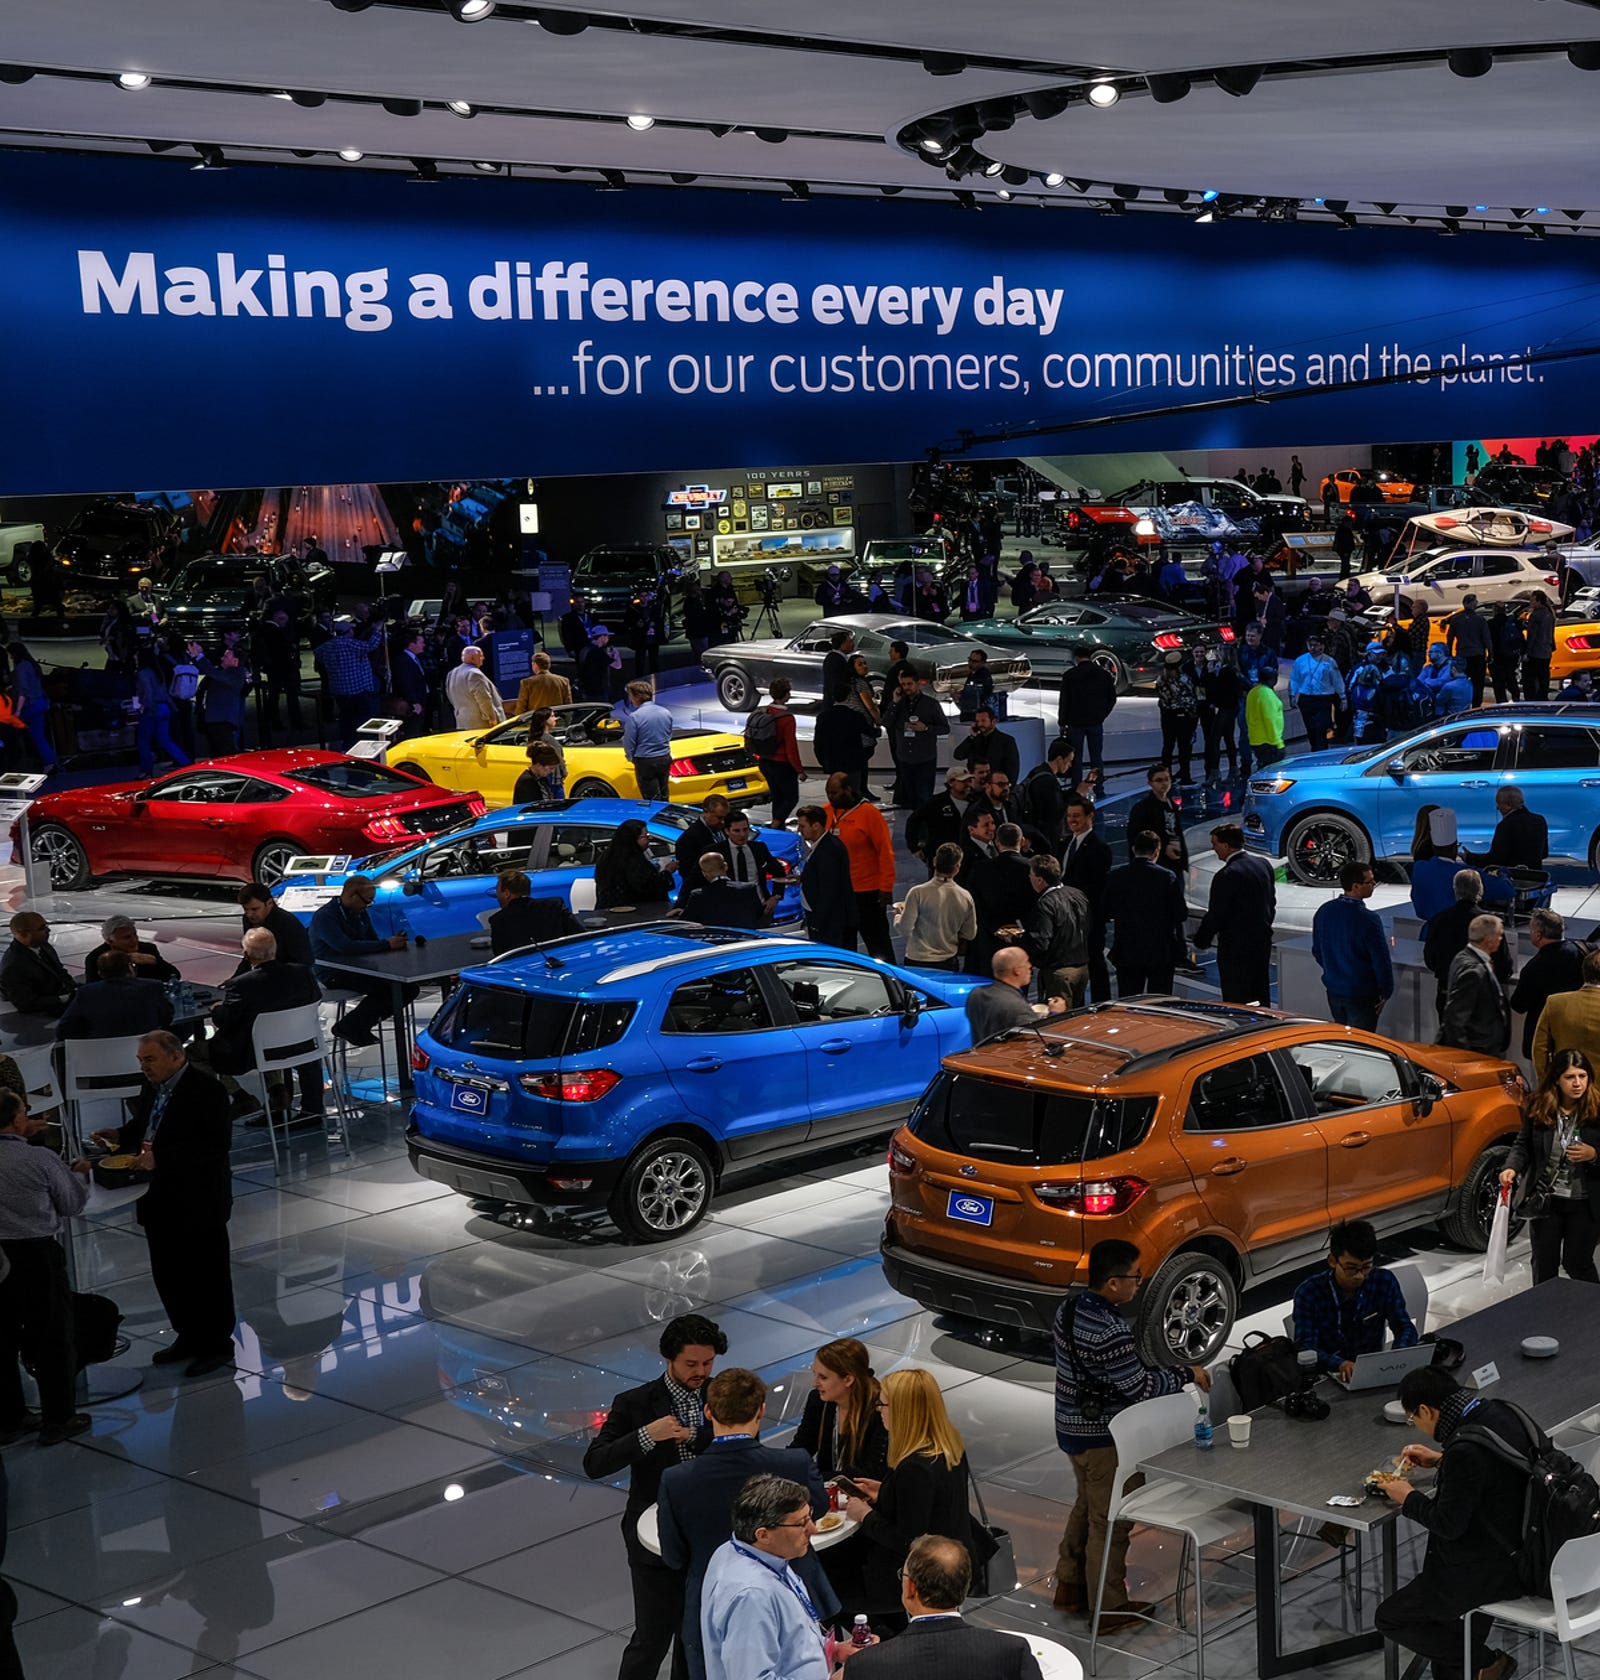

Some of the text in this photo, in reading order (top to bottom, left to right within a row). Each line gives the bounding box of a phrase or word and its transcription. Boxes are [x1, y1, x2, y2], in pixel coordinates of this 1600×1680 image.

[77, 249, 1065, 336] Making a difference every day
[667, 353, 755, 395] our
[769, 344, 1030, 396] customers,
[1041, 342, 1296, 389] communities
[1305, 342, 1370, 387] and
[1378, 342, 1432, 385] the
[1440, 345, 1545, 393] planet.
[746, 470, 811, 480] 100 YEARS
[1379, 1362, 1408, 1373] VAIO
